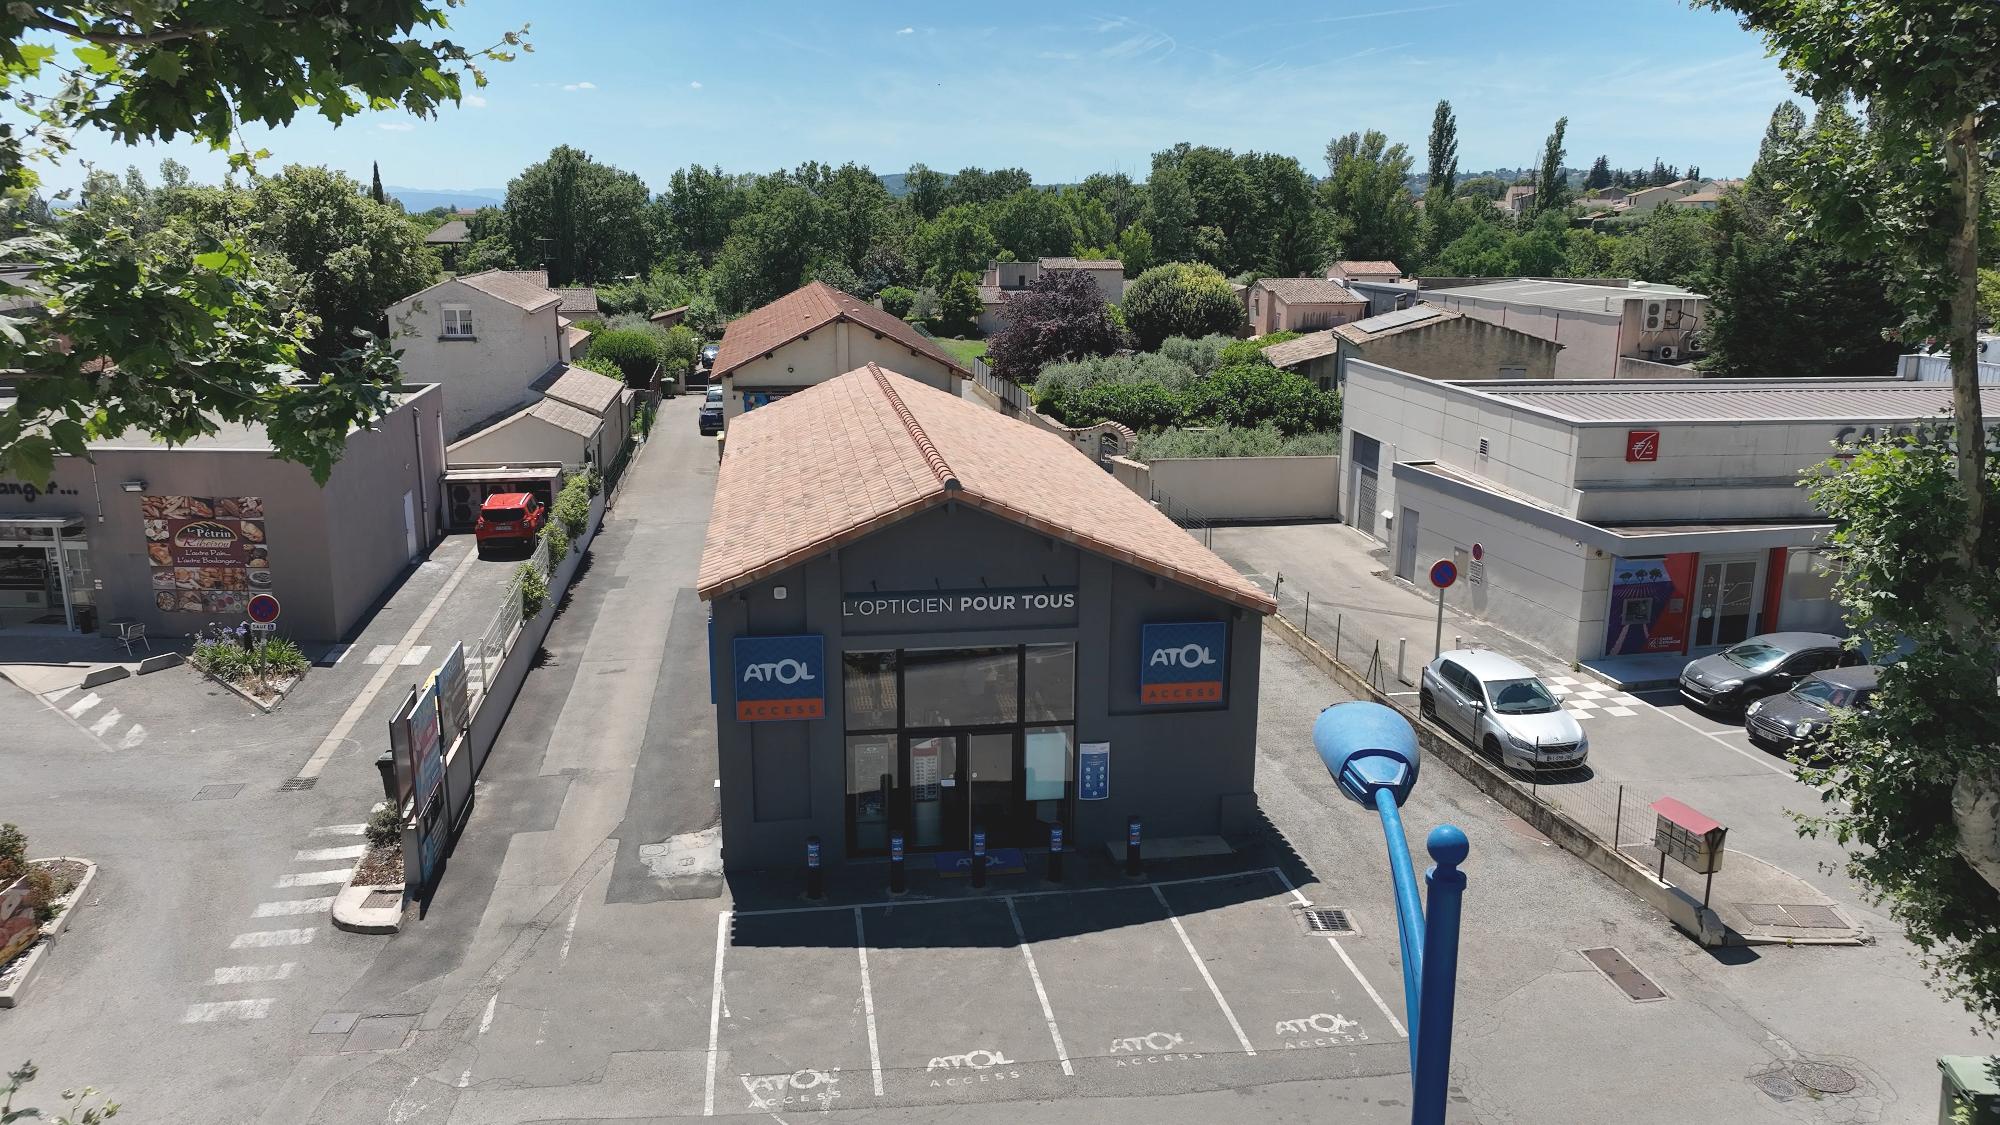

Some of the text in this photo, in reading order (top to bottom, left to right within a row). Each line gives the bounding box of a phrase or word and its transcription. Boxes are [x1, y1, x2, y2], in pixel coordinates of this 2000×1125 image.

[196, 527, 231, 538] Pétrin
[842, 593, 1075, 616] L'OPTICIEN POUR TOUS
[1150, 643, 1217, 669] ATOL
[743, 658, 816, 685] ATOL
[1149, 688, 1216, 699] ACCESS
[744, 704, 817, 716] ACCESS
[927, 1050, 1015, 1072] ATOL
[929, 1071, 1020, 1088] ACCESS
